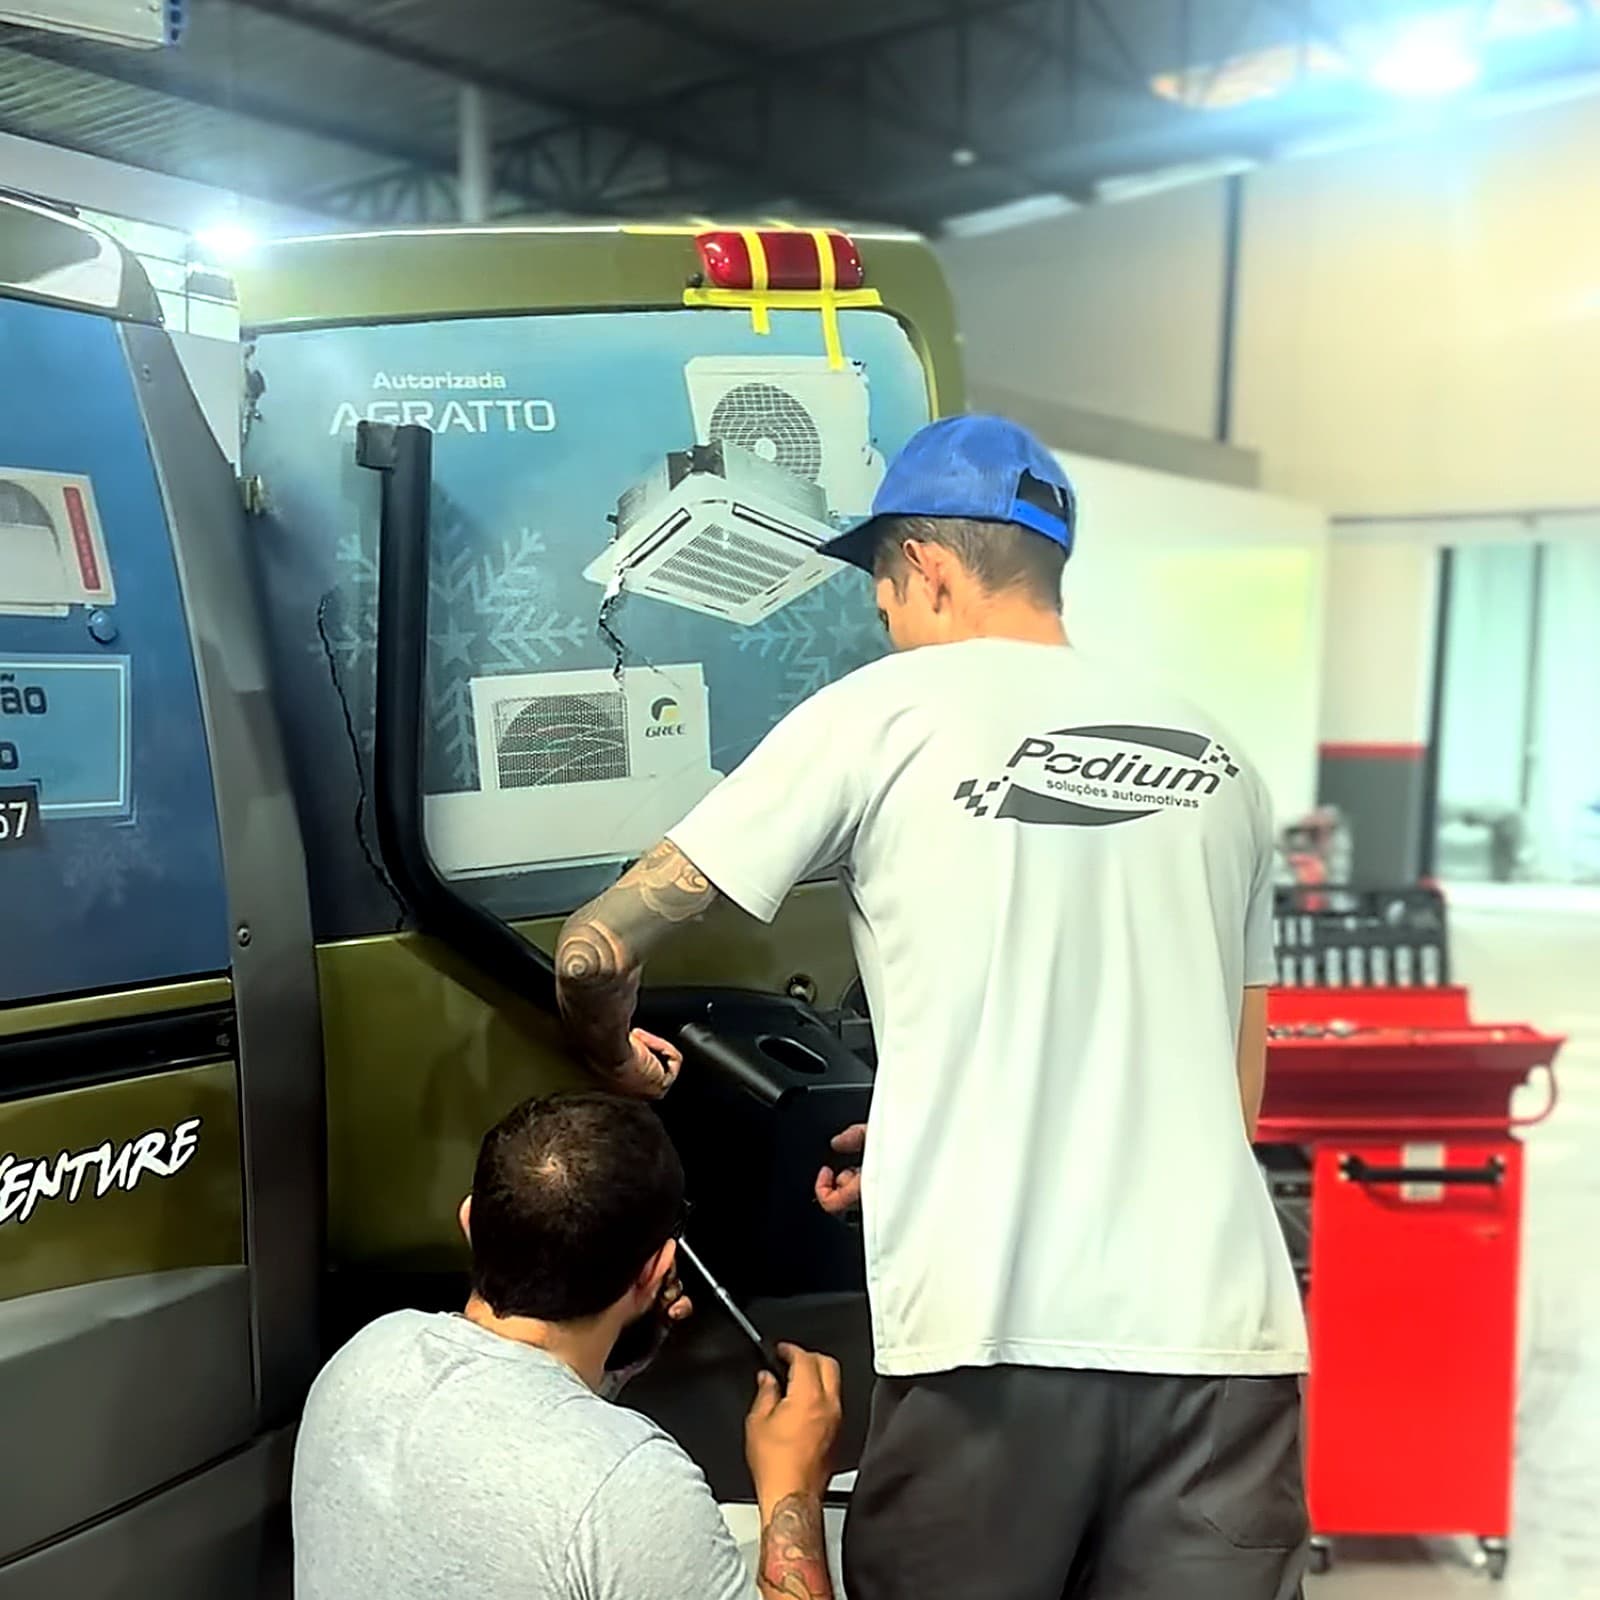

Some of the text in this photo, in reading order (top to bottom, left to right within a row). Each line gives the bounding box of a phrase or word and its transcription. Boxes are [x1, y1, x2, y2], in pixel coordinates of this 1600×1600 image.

[372, 371, 507, 390] Autorizada
[329, 400, 557, 434] AGRATTO
[1006, 737, 1221, 795] Podium
[1046, 779, 1200, 808] soluções automotivas
